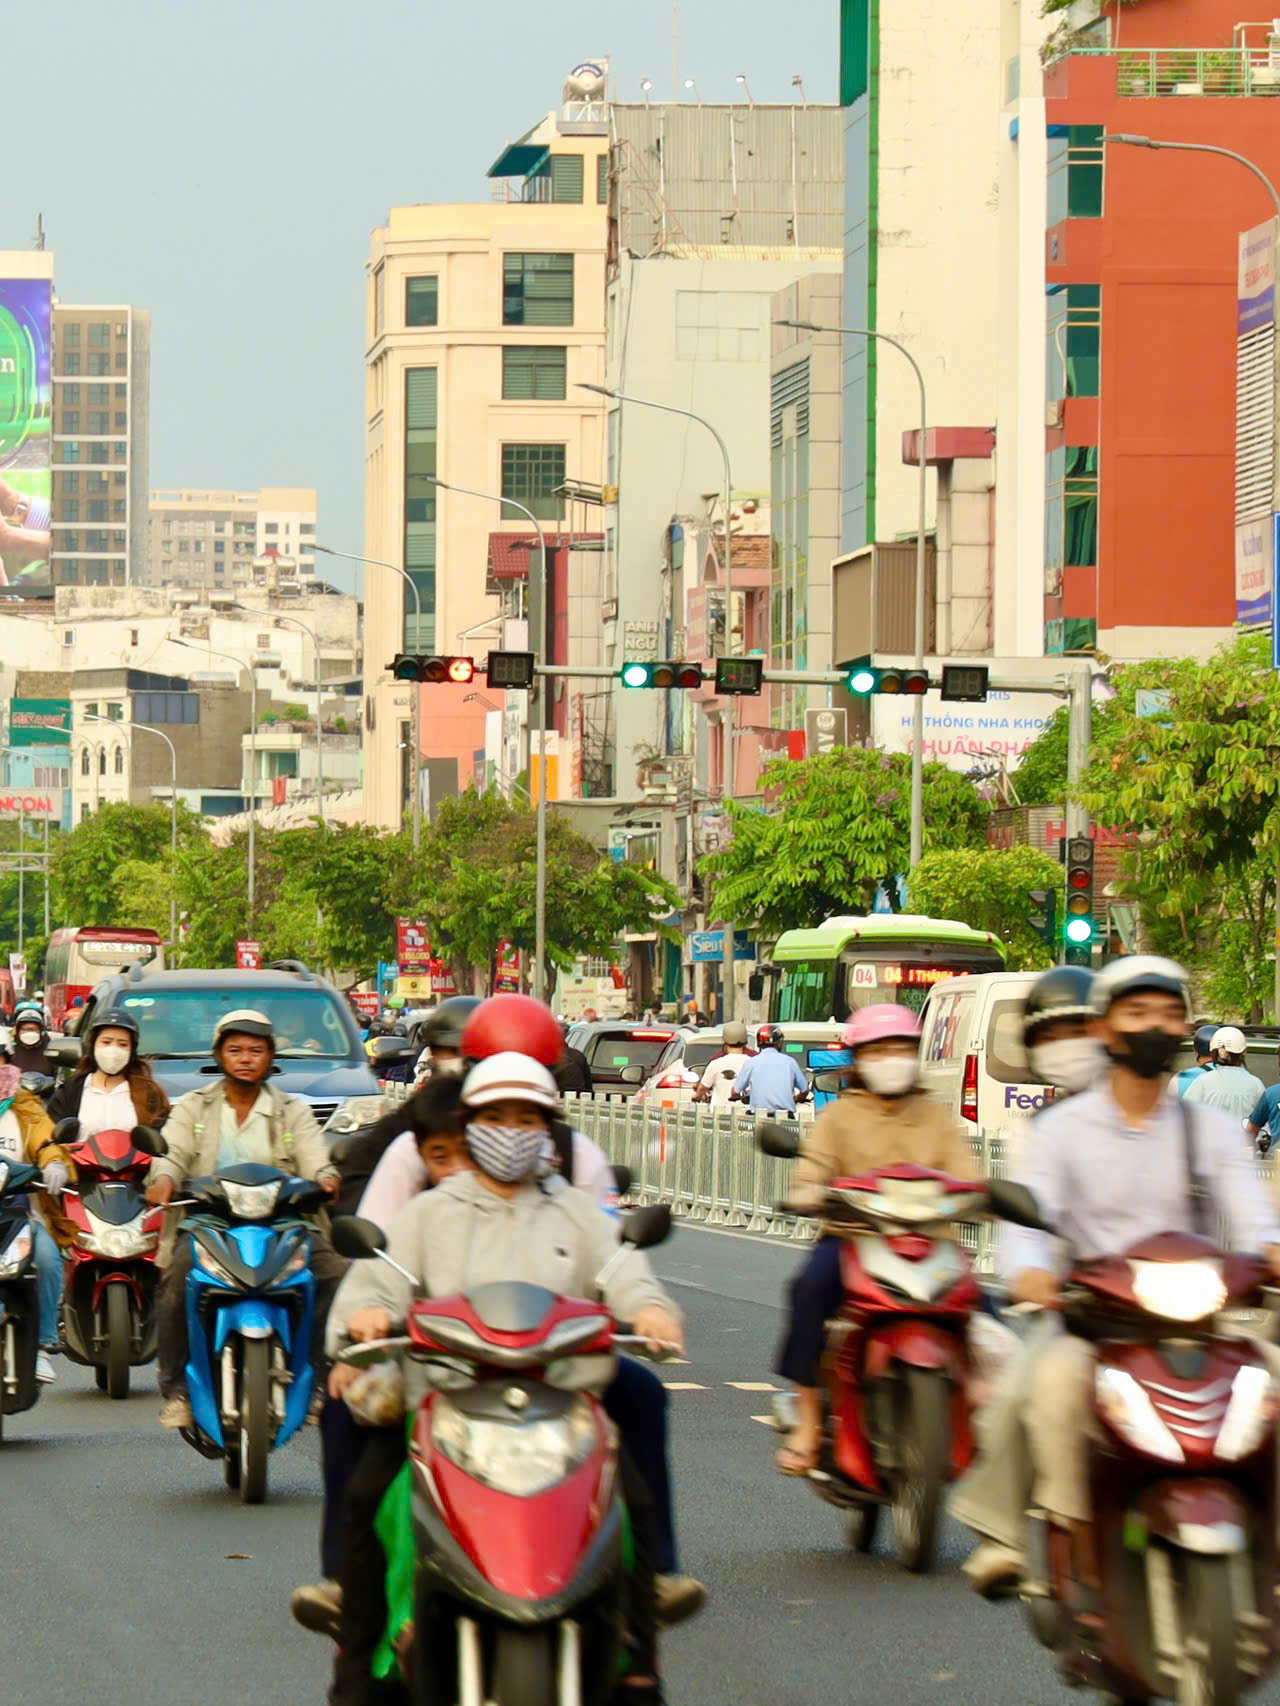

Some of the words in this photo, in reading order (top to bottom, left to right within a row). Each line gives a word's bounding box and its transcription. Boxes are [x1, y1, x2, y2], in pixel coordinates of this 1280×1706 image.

[625, 621, 658, 633] ANH
[924, 712, 974, 728] THỐNG
[978, 718, 1009, 729] NHA
[854, 967, 873, 984] 04
[884, 966, 902, 983] 04
[1004, 1086, 1055, 1113] Fed
